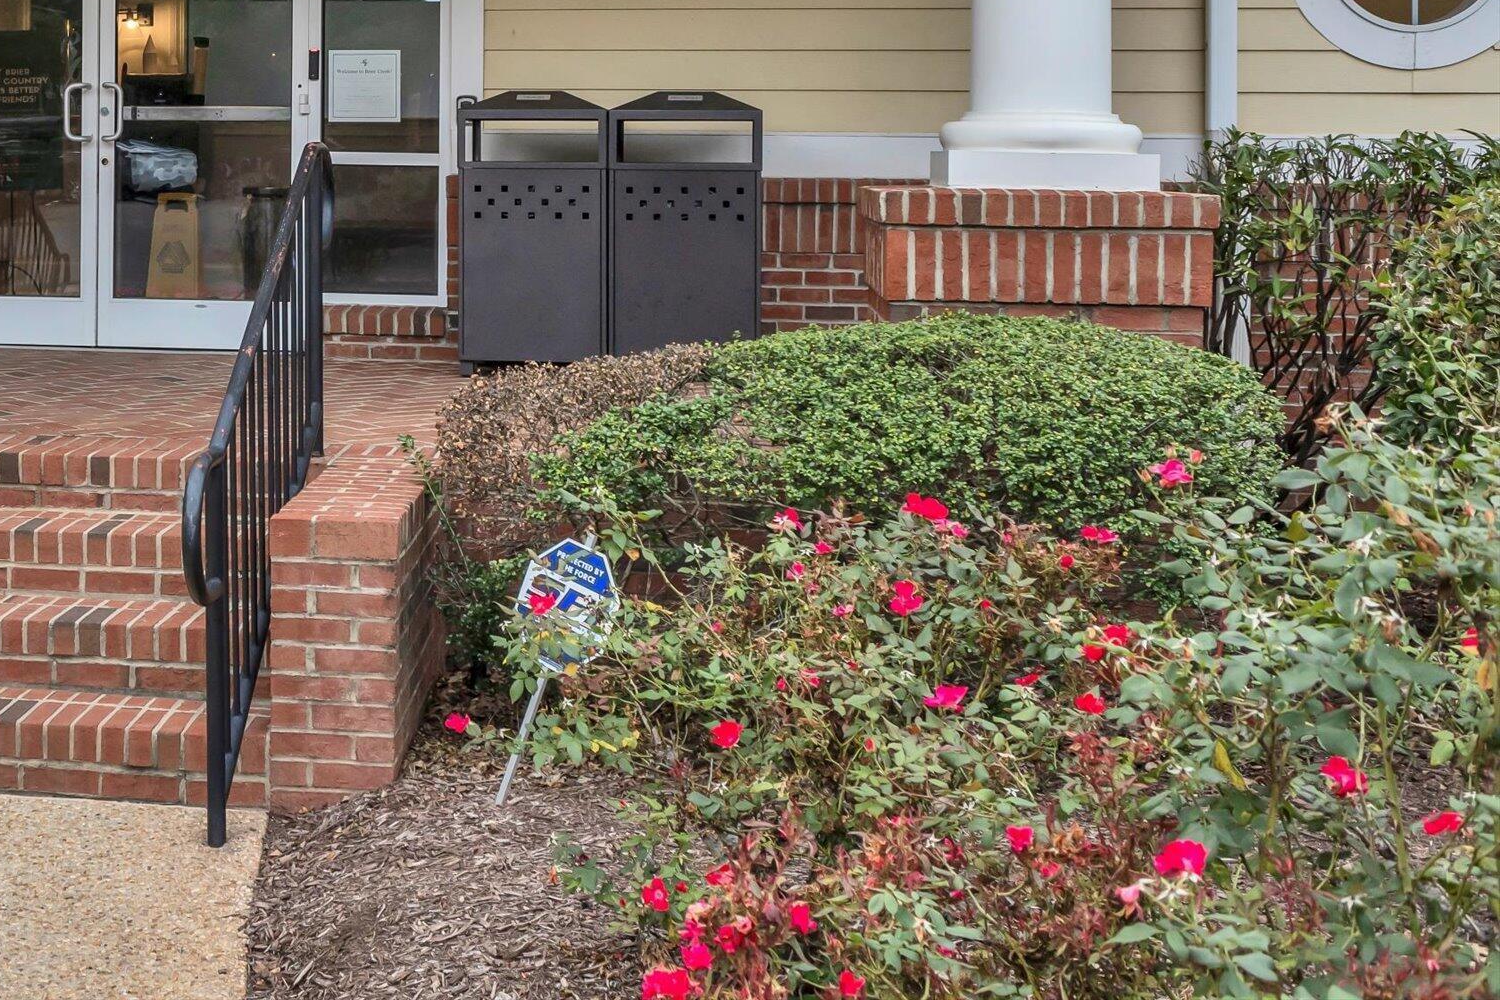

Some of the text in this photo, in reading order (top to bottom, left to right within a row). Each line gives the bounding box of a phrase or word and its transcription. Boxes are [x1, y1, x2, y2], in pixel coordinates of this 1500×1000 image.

[3, 76, 49, 85] COUNTRY
[8, 86, 40, 94] BETTER
[556, 549, 605, 578] PRECTED BY
[573, 568, 597, 585] FORCE
